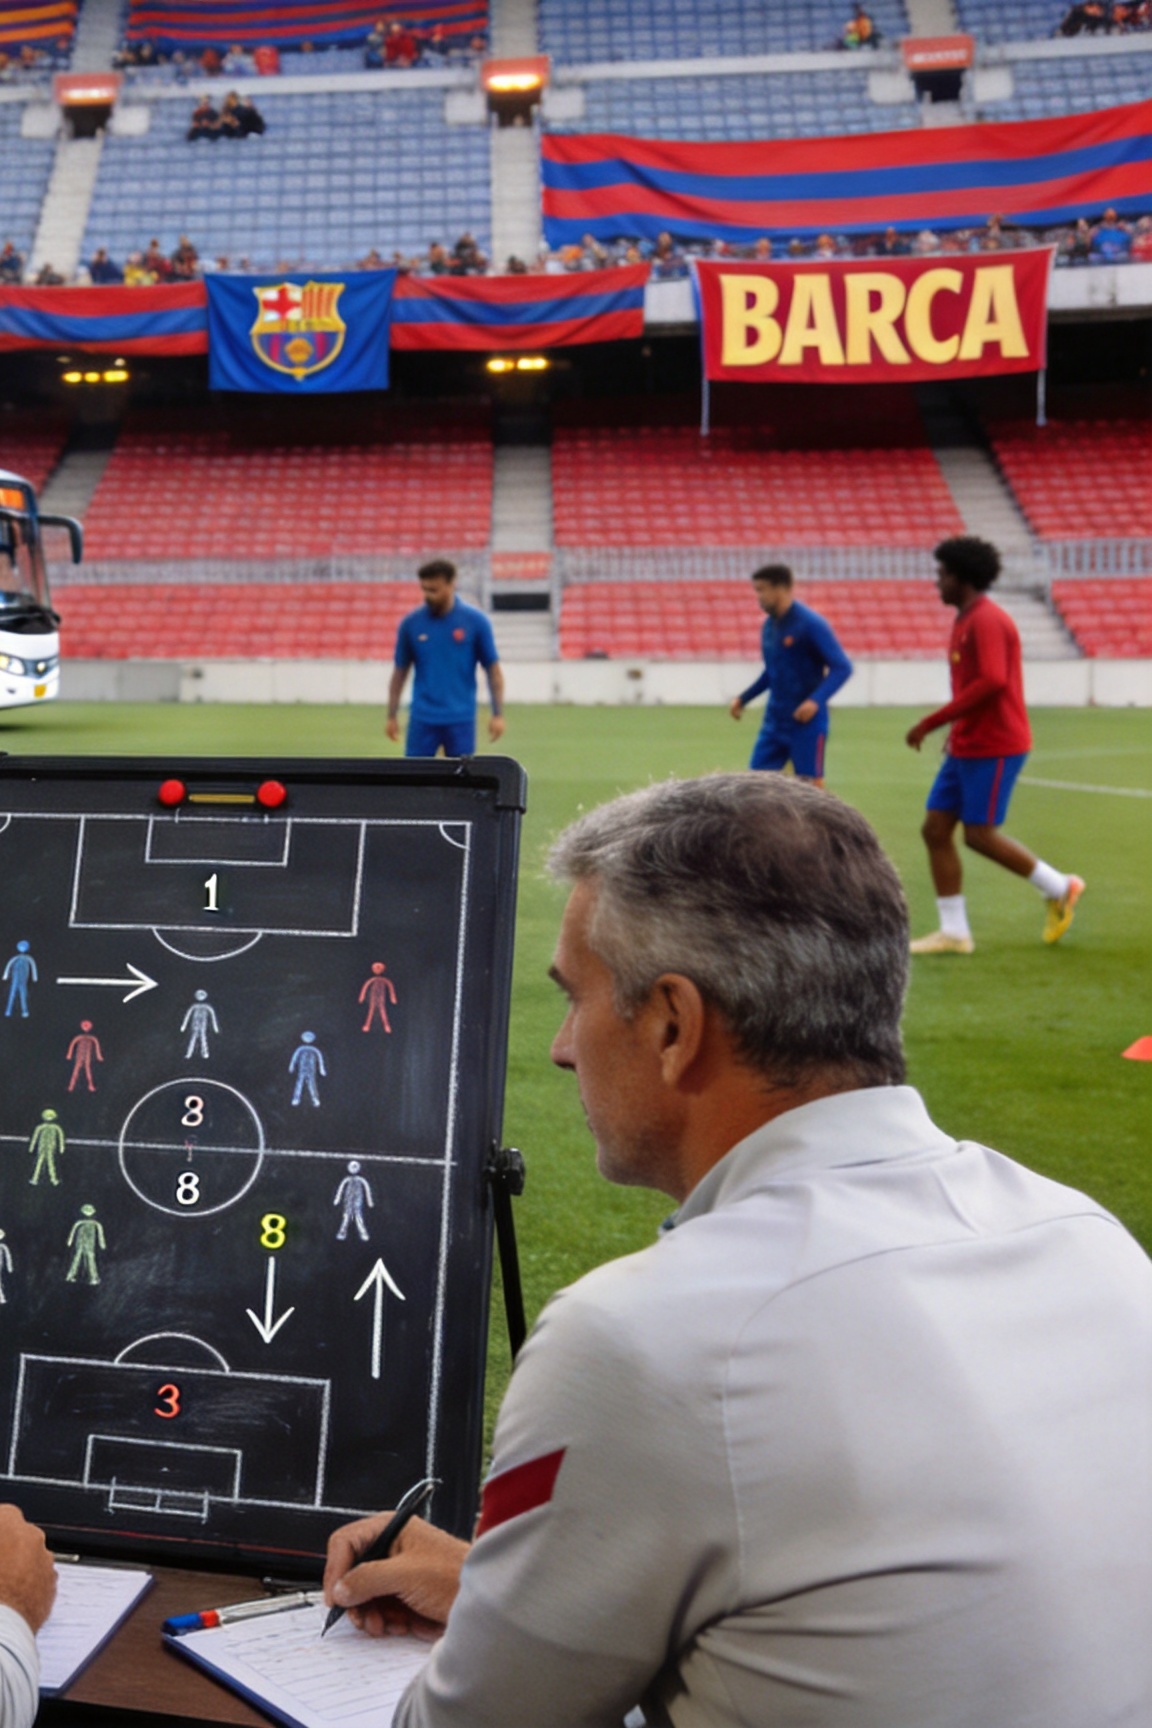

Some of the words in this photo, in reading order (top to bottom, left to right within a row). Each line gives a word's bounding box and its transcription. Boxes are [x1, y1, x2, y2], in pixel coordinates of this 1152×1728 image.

[719, 264, 1030, 366] BARCA
[203, 873, 219, 911] 1
[176, 1172, 200, 1205] 8
[260, 1213, 286, 1249] 8
[154, 1383, 181, 1419] 3
